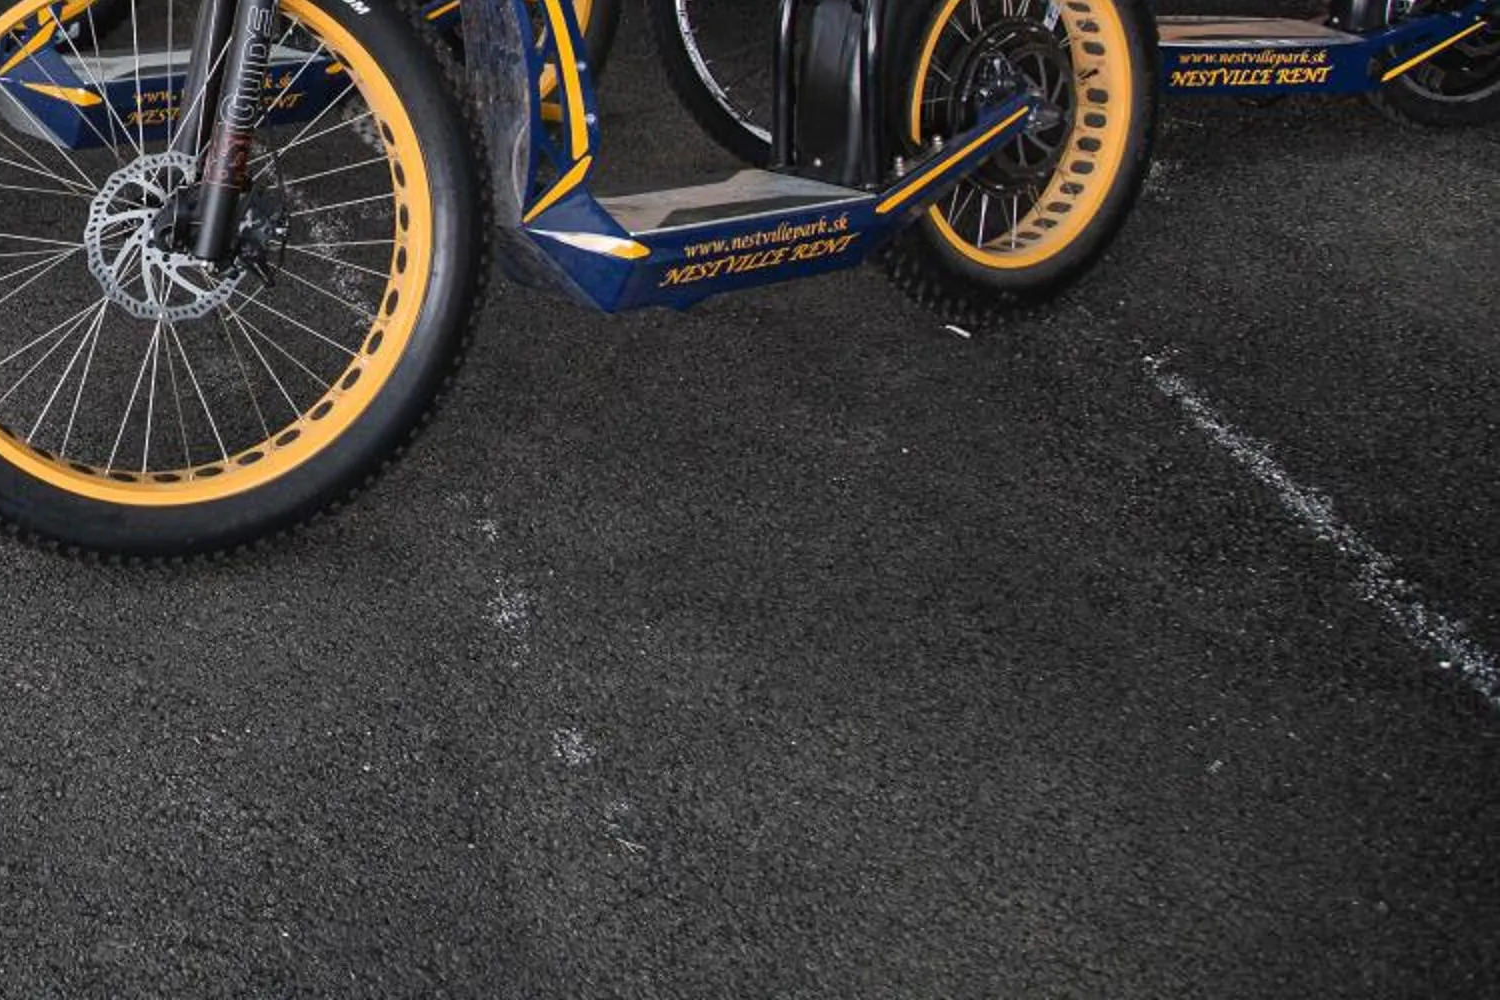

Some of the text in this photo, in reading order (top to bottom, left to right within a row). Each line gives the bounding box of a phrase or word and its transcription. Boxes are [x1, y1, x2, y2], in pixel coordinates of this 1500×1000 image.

[1179, 48, 1327, 67] www.nestvillepark.sk
[1169, 65, 1336, 88] NESTVILLE RENT
[683, 211, 849, 257] www.nestvillepark.sk
[659, 231, 862, 288] NESTVILLE RENT
